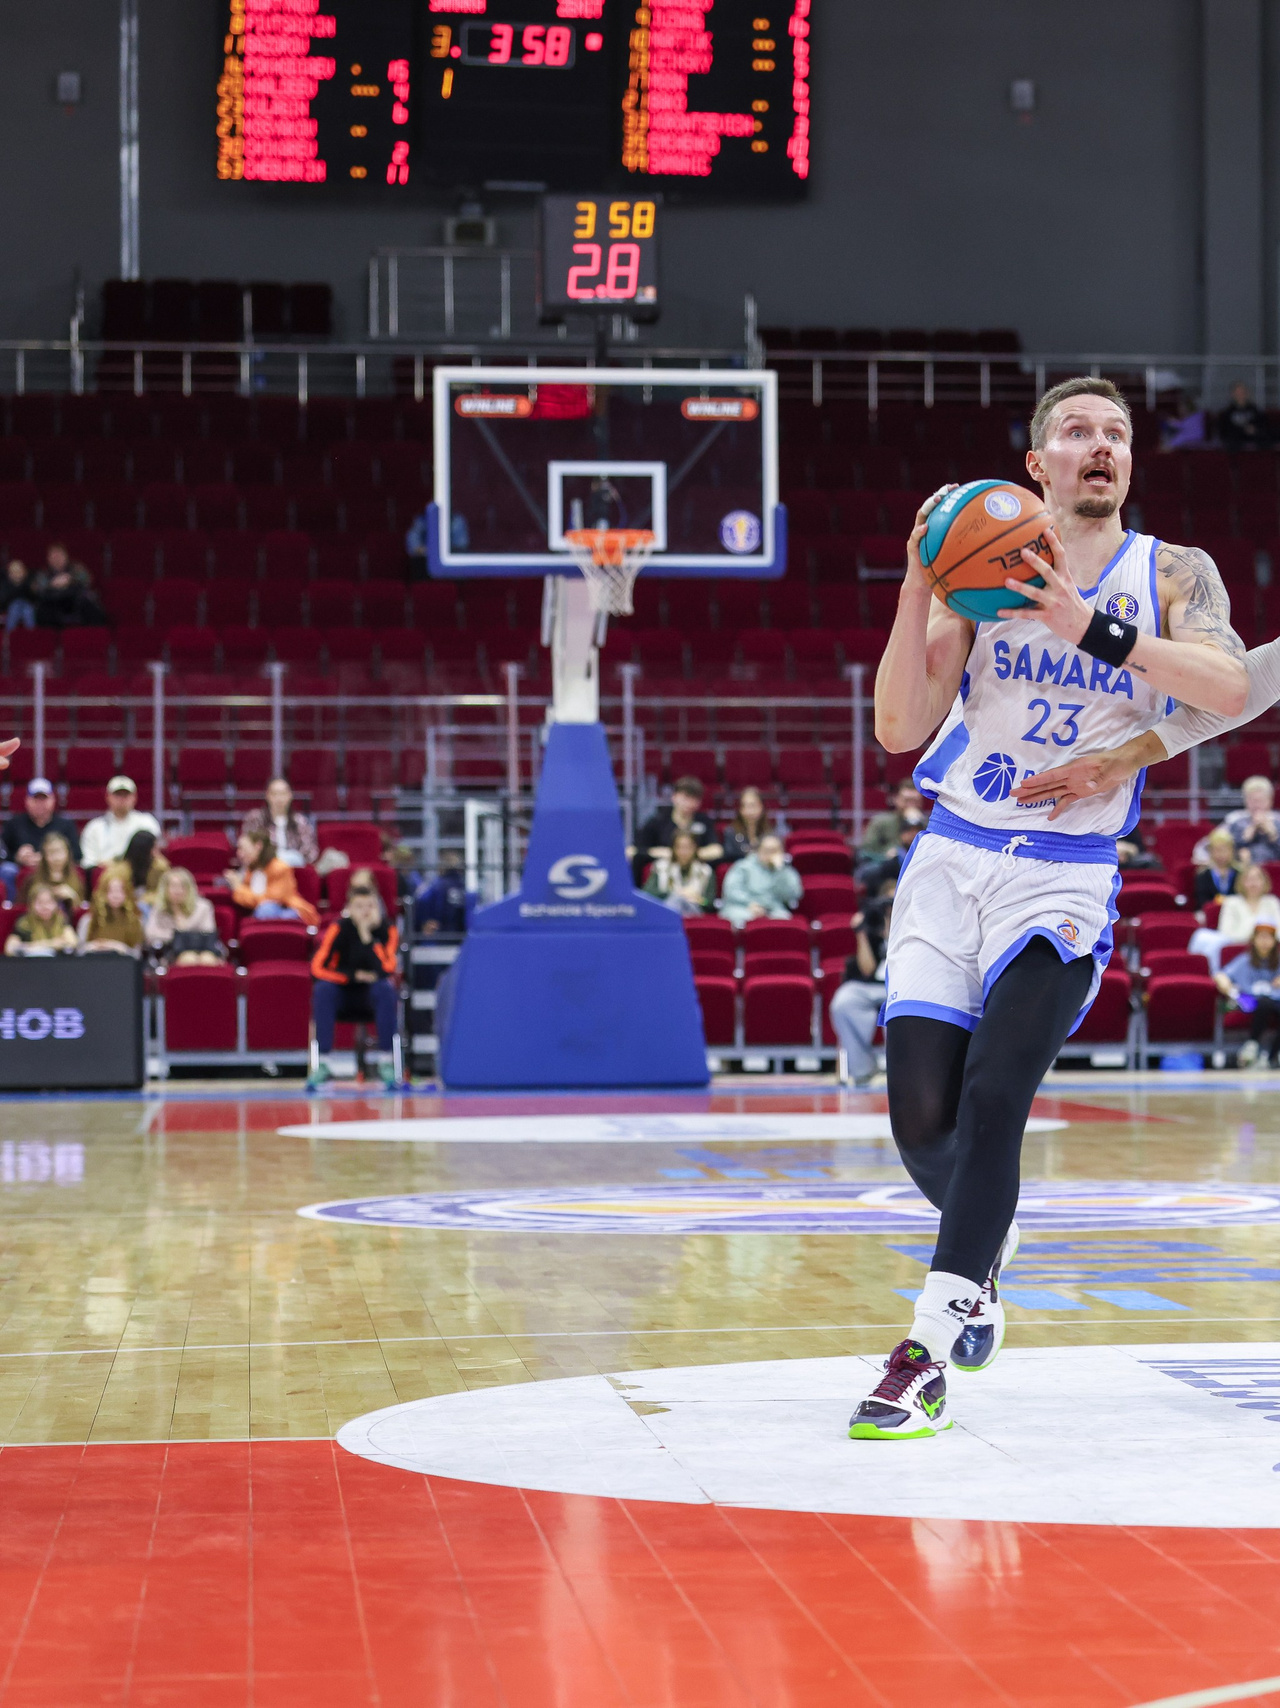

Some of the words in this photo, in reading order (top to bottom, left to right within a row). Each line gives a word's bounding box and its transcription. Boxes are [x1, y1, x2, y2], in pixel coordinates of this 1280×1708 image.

[566, 243, 640, 299] 2.8
[993, 640, 1134, 700] SAMARA
[1021, 698, 1086, 747] 23
